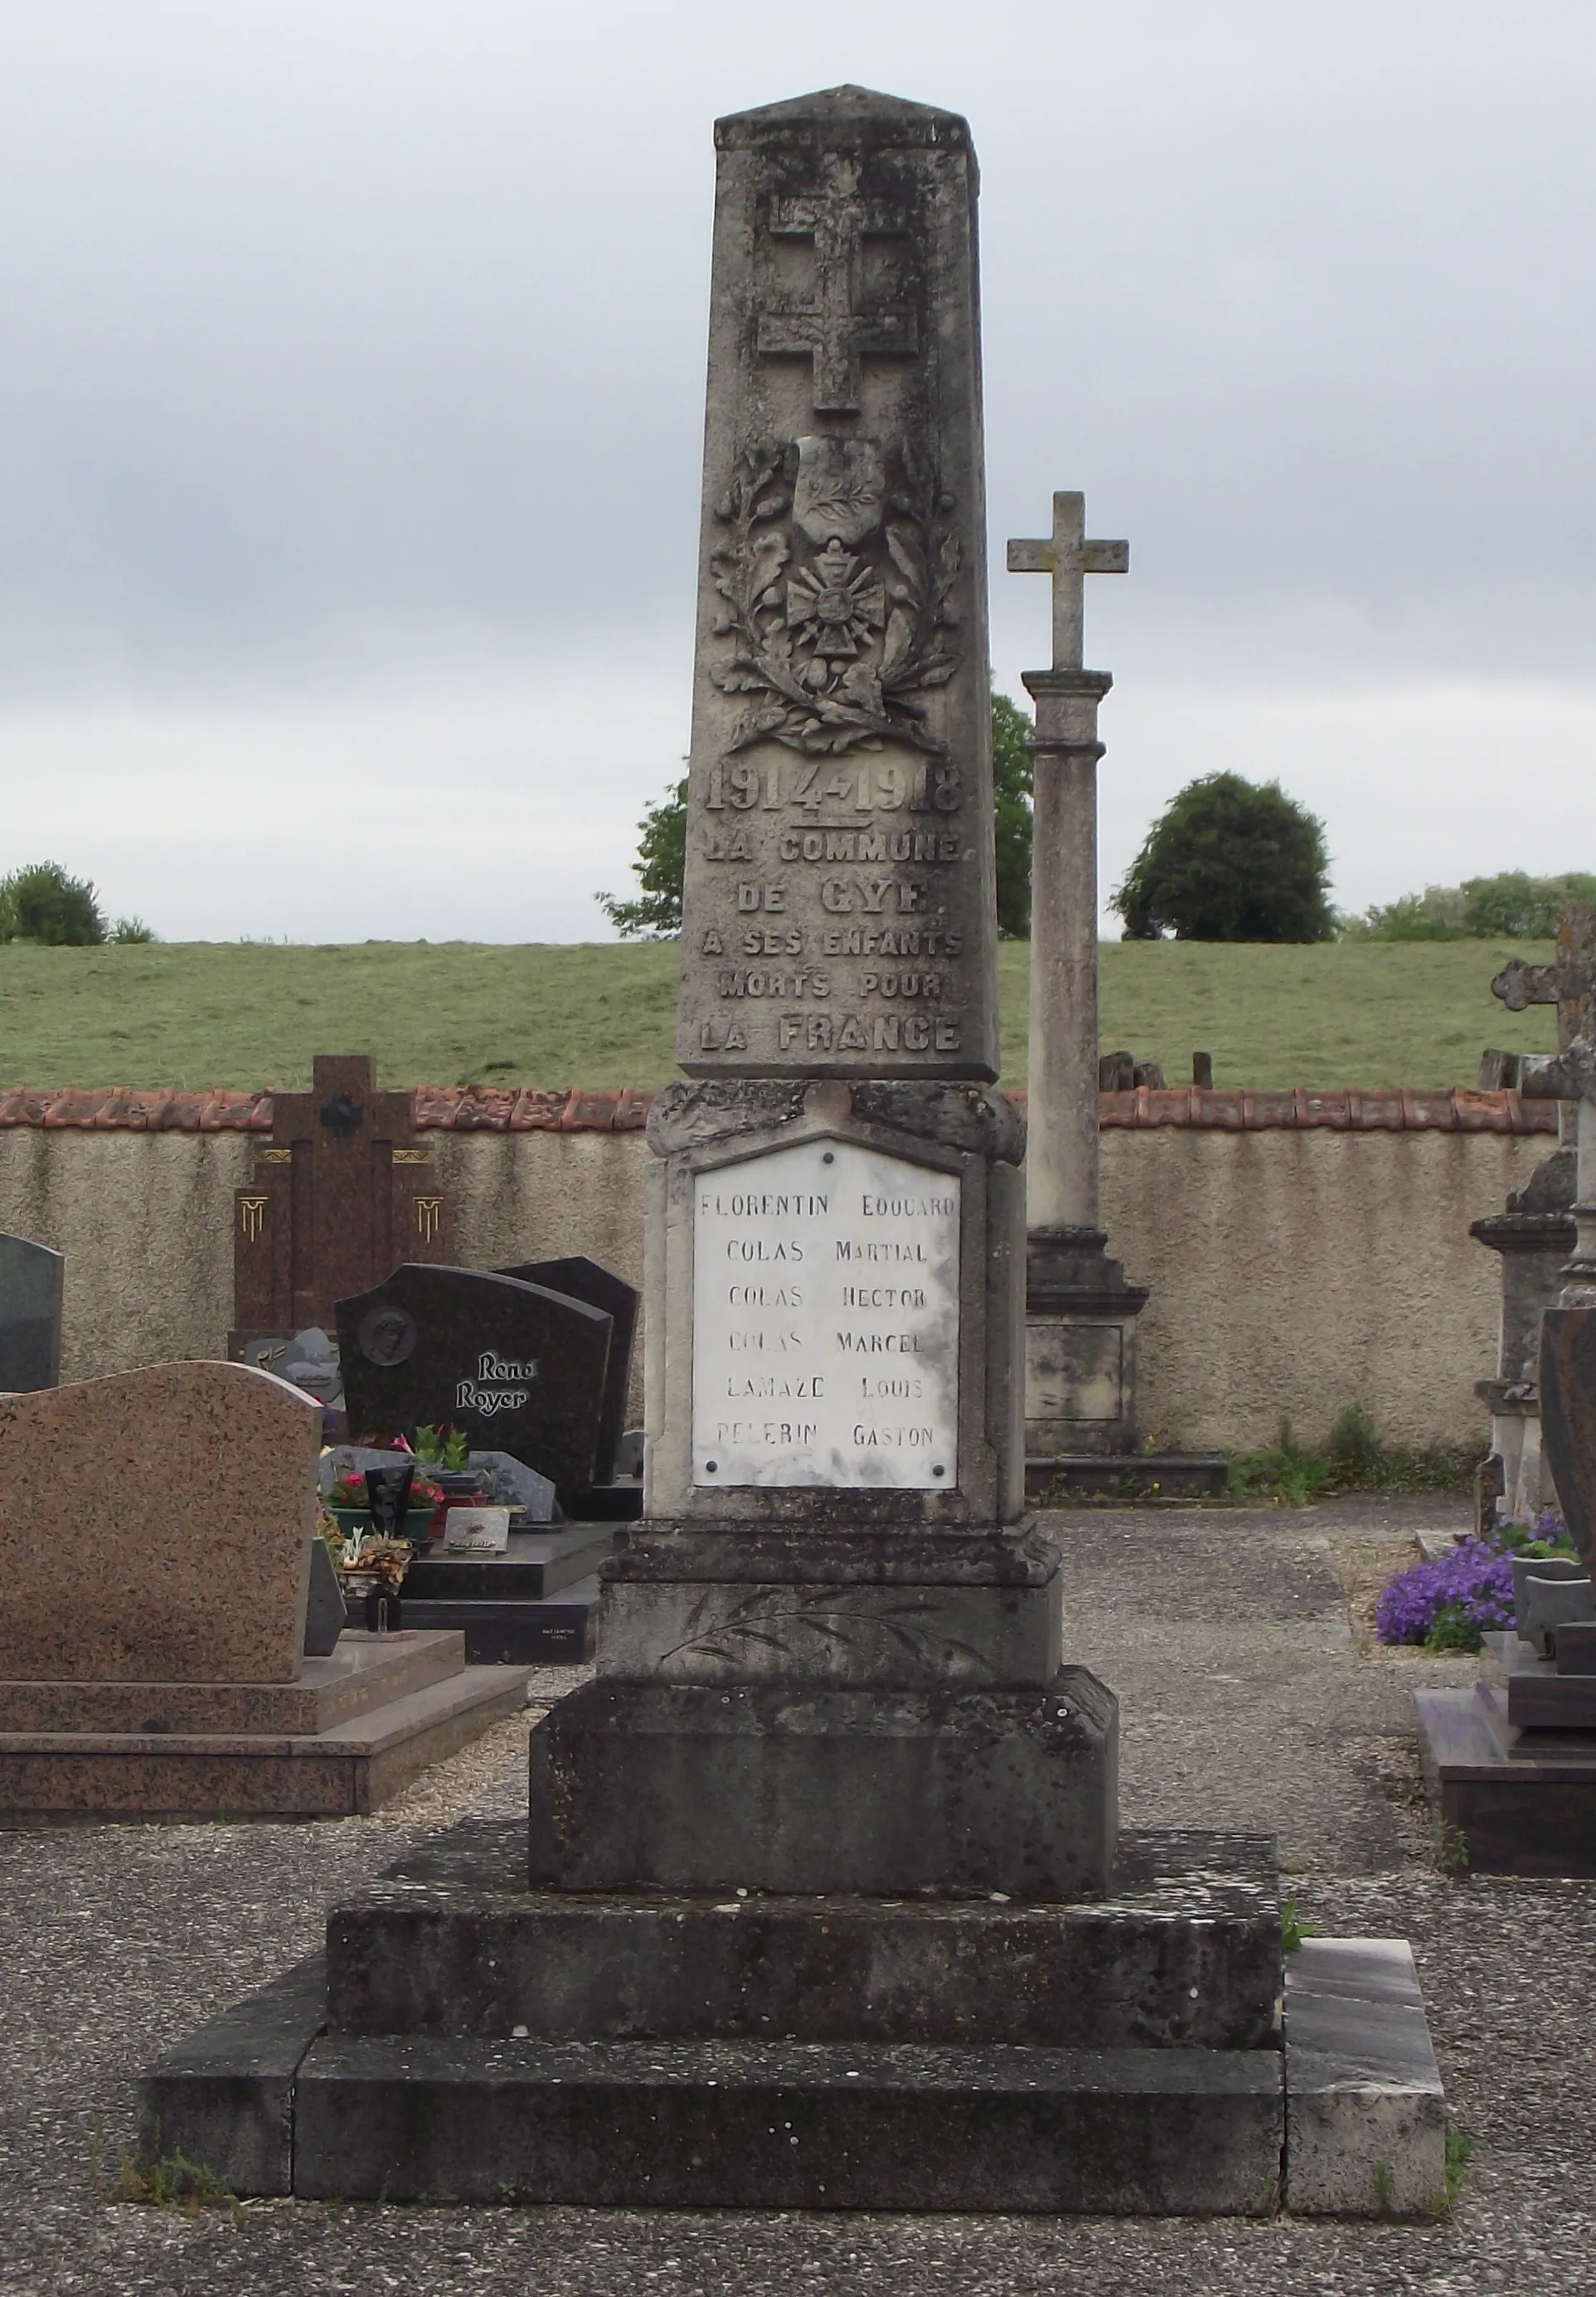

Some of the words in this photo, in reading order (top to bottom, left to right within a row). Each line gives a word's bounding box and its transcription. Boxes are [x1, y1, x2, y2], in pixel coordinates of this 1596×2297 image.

[705, 762, 963, 813] 1914-1918
[706, 833, 753, 861] LA
[779, 832, 959, 862] COMMUNE
[738, 882, 785, 913] DE
[745, 930, 802, 955] SES
[823, 929, 963, 955] ENFANTS
[720, 970, 830, 997] MORTS
[859, 972, 942, 997] POUR
[701, 1022, 746, 1050] LA
[779, 1013, 960, 1051] FRANCE
[701, 1194, 828, 1216] FLORENTIN
[862, 1194, 955, 1216] EDOUARD
[727, 1240, 804, 1261] COLAS
[836, 1241, 928, 1262] MARTIAL
[729, 1285, 803, 1307] COLAS
[842, 1287, 928, 1308] HECTOR
[730, 1331, 803, 1352] COLAS
[837, 1332, 924, 1353] MARCEL
[457, 1381, 527, 1416] Royer
[727, 1377, 824, 1398] LAMAZE
[862, 1377, 923, 1398] LOUIS
[716, 1422, 817, 1445] PELERIN
[853, 1424, 934, 1446] GASTON
